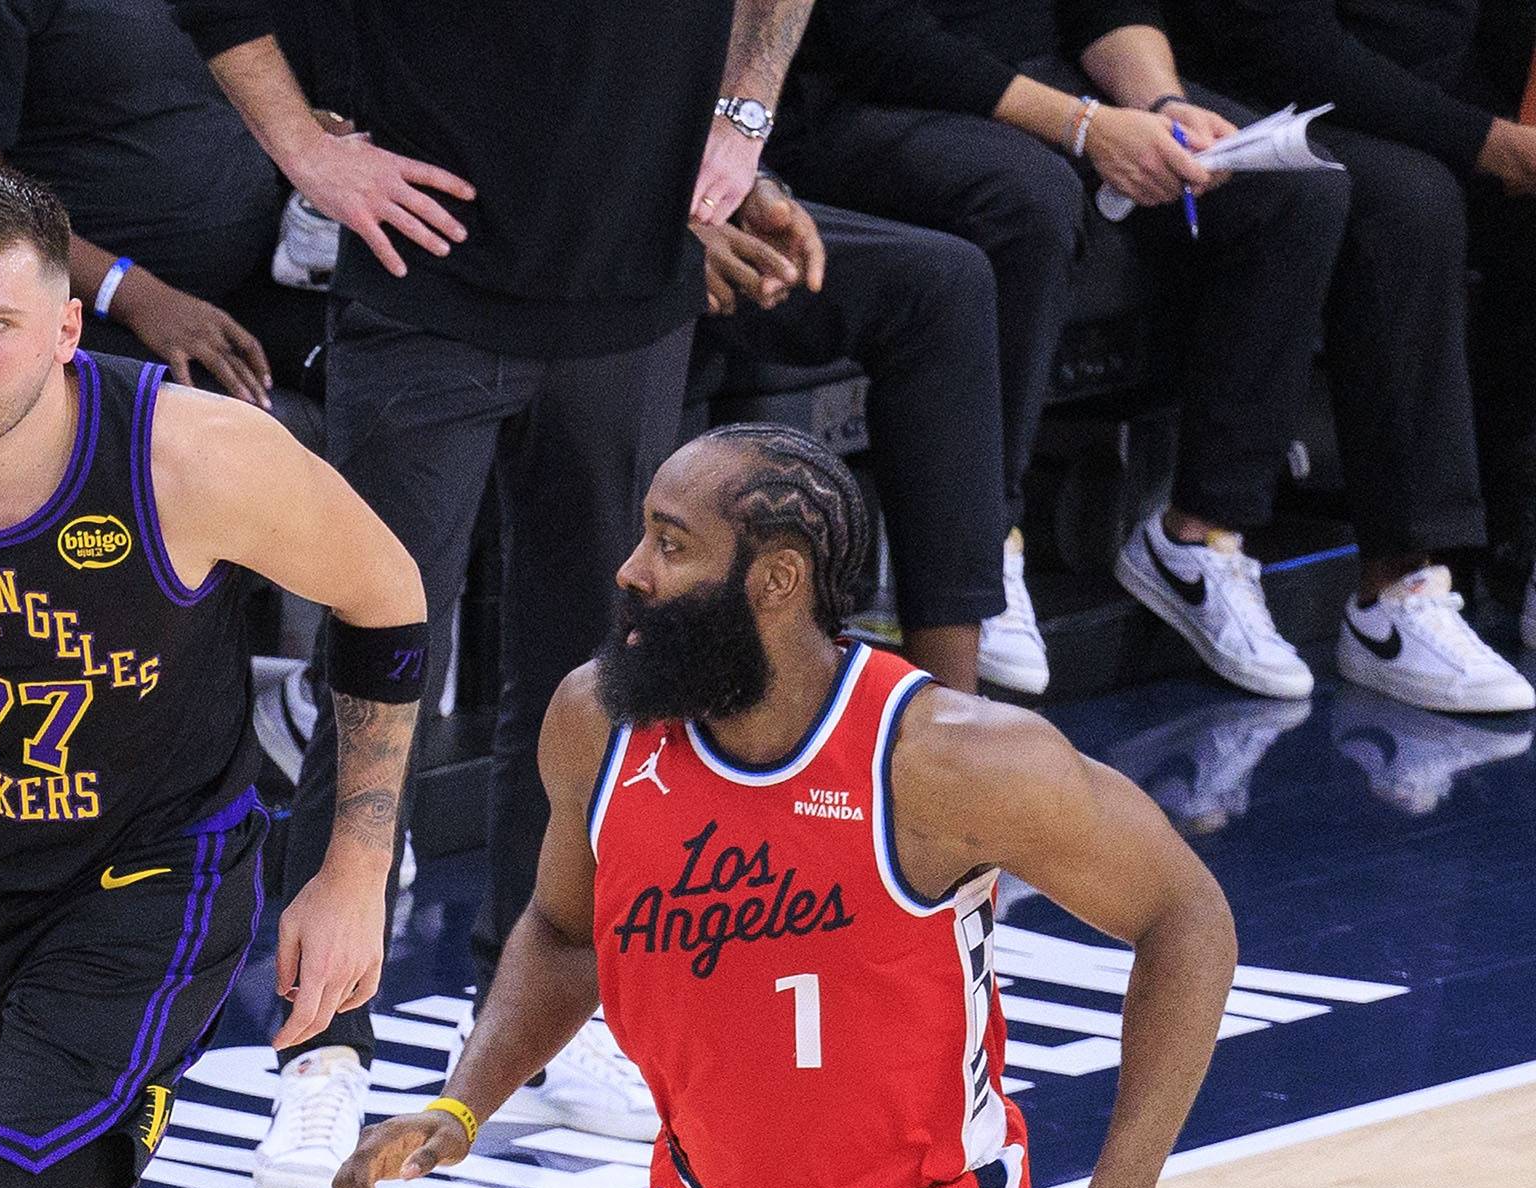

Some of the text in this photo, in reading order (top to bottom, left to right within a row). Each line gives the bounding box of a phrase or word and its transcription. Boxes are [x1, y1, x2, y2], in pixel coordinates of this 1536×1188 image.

[64, 529, 127, 552] bibigo
[794, 801, 864, 821] RWANDA
[809, 788, 849, 805] VISIT
[672, 820, 778, 898] Los
[614, 870, 857, 979] Angeles
[775, 973, 822, 1069] 1
